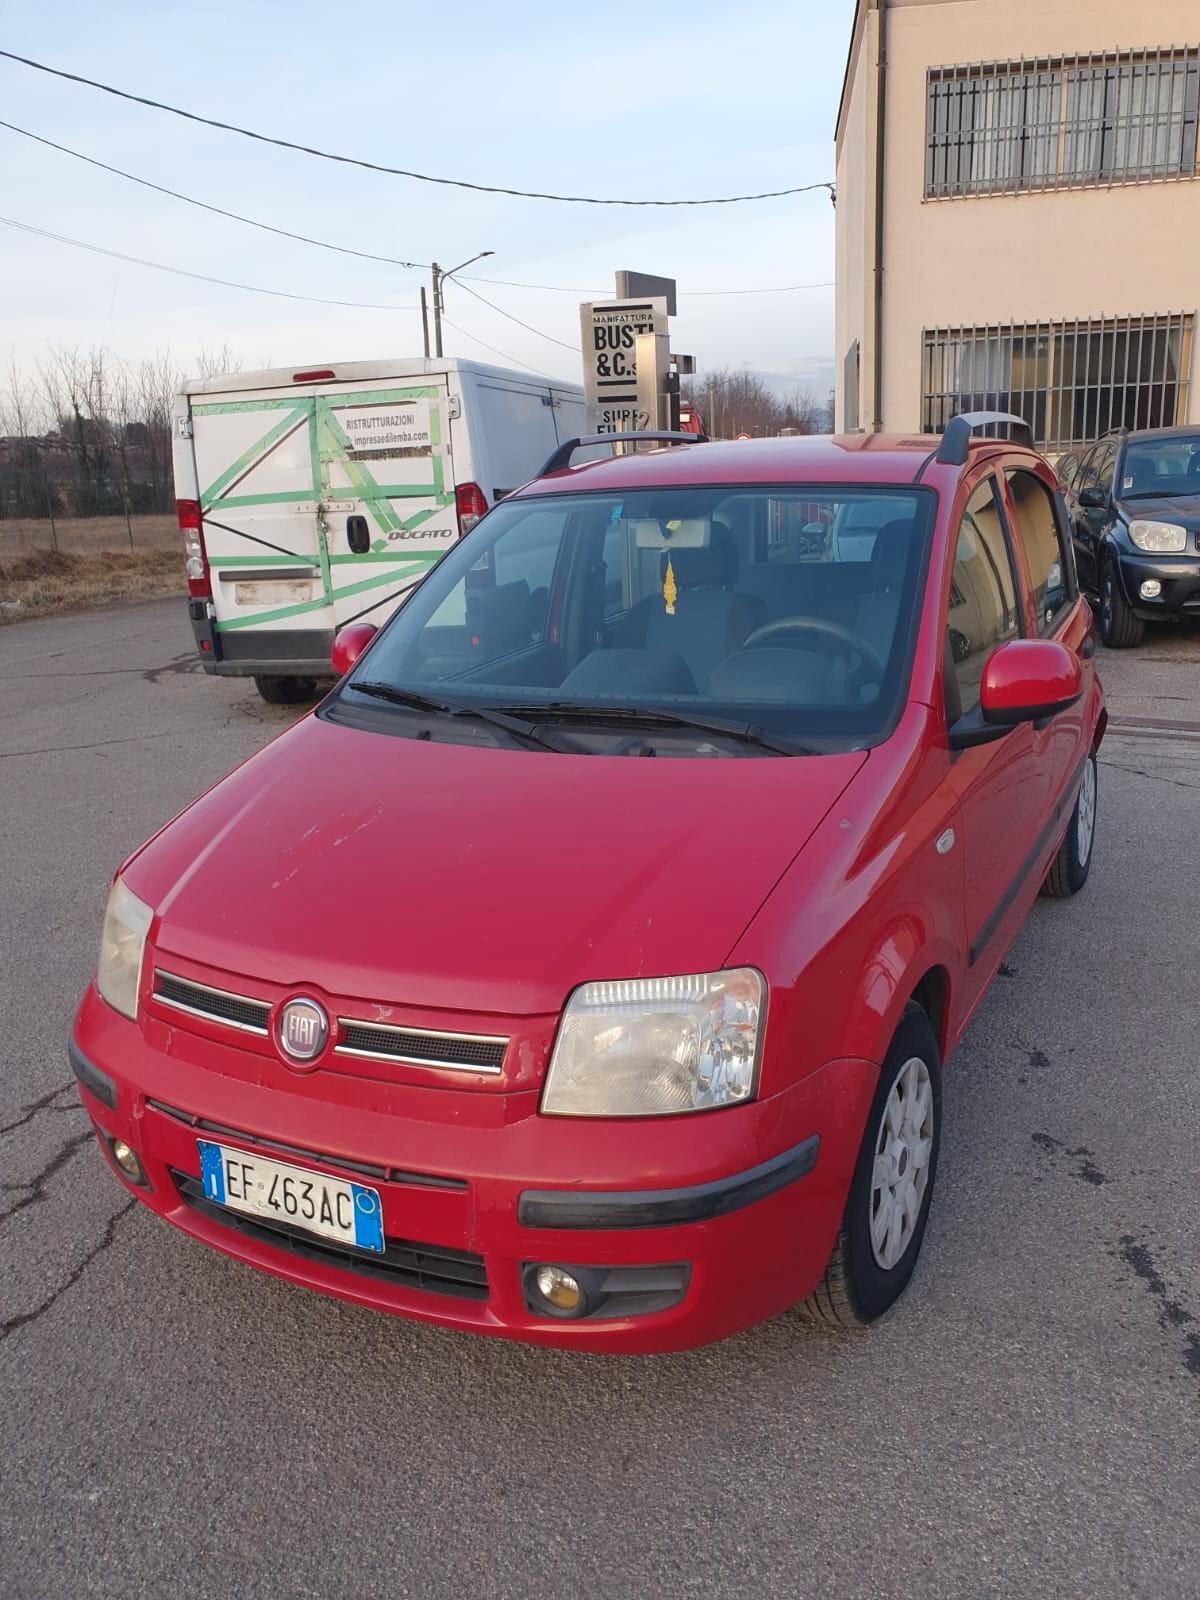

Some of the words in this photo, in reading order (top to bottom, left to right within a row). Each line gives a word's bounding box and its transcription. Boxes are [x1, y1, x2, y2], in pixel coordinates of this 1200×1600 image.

[593, 313, 653, 323] MANIFATTURA
[346, 414, 415, 430] RISTRUTTURAZIONI
[388, 529, 453, 541] DUCATO
[289, 1015, 318, 1046] FIAT
[267, 1174, 353, 1230] 463AC
